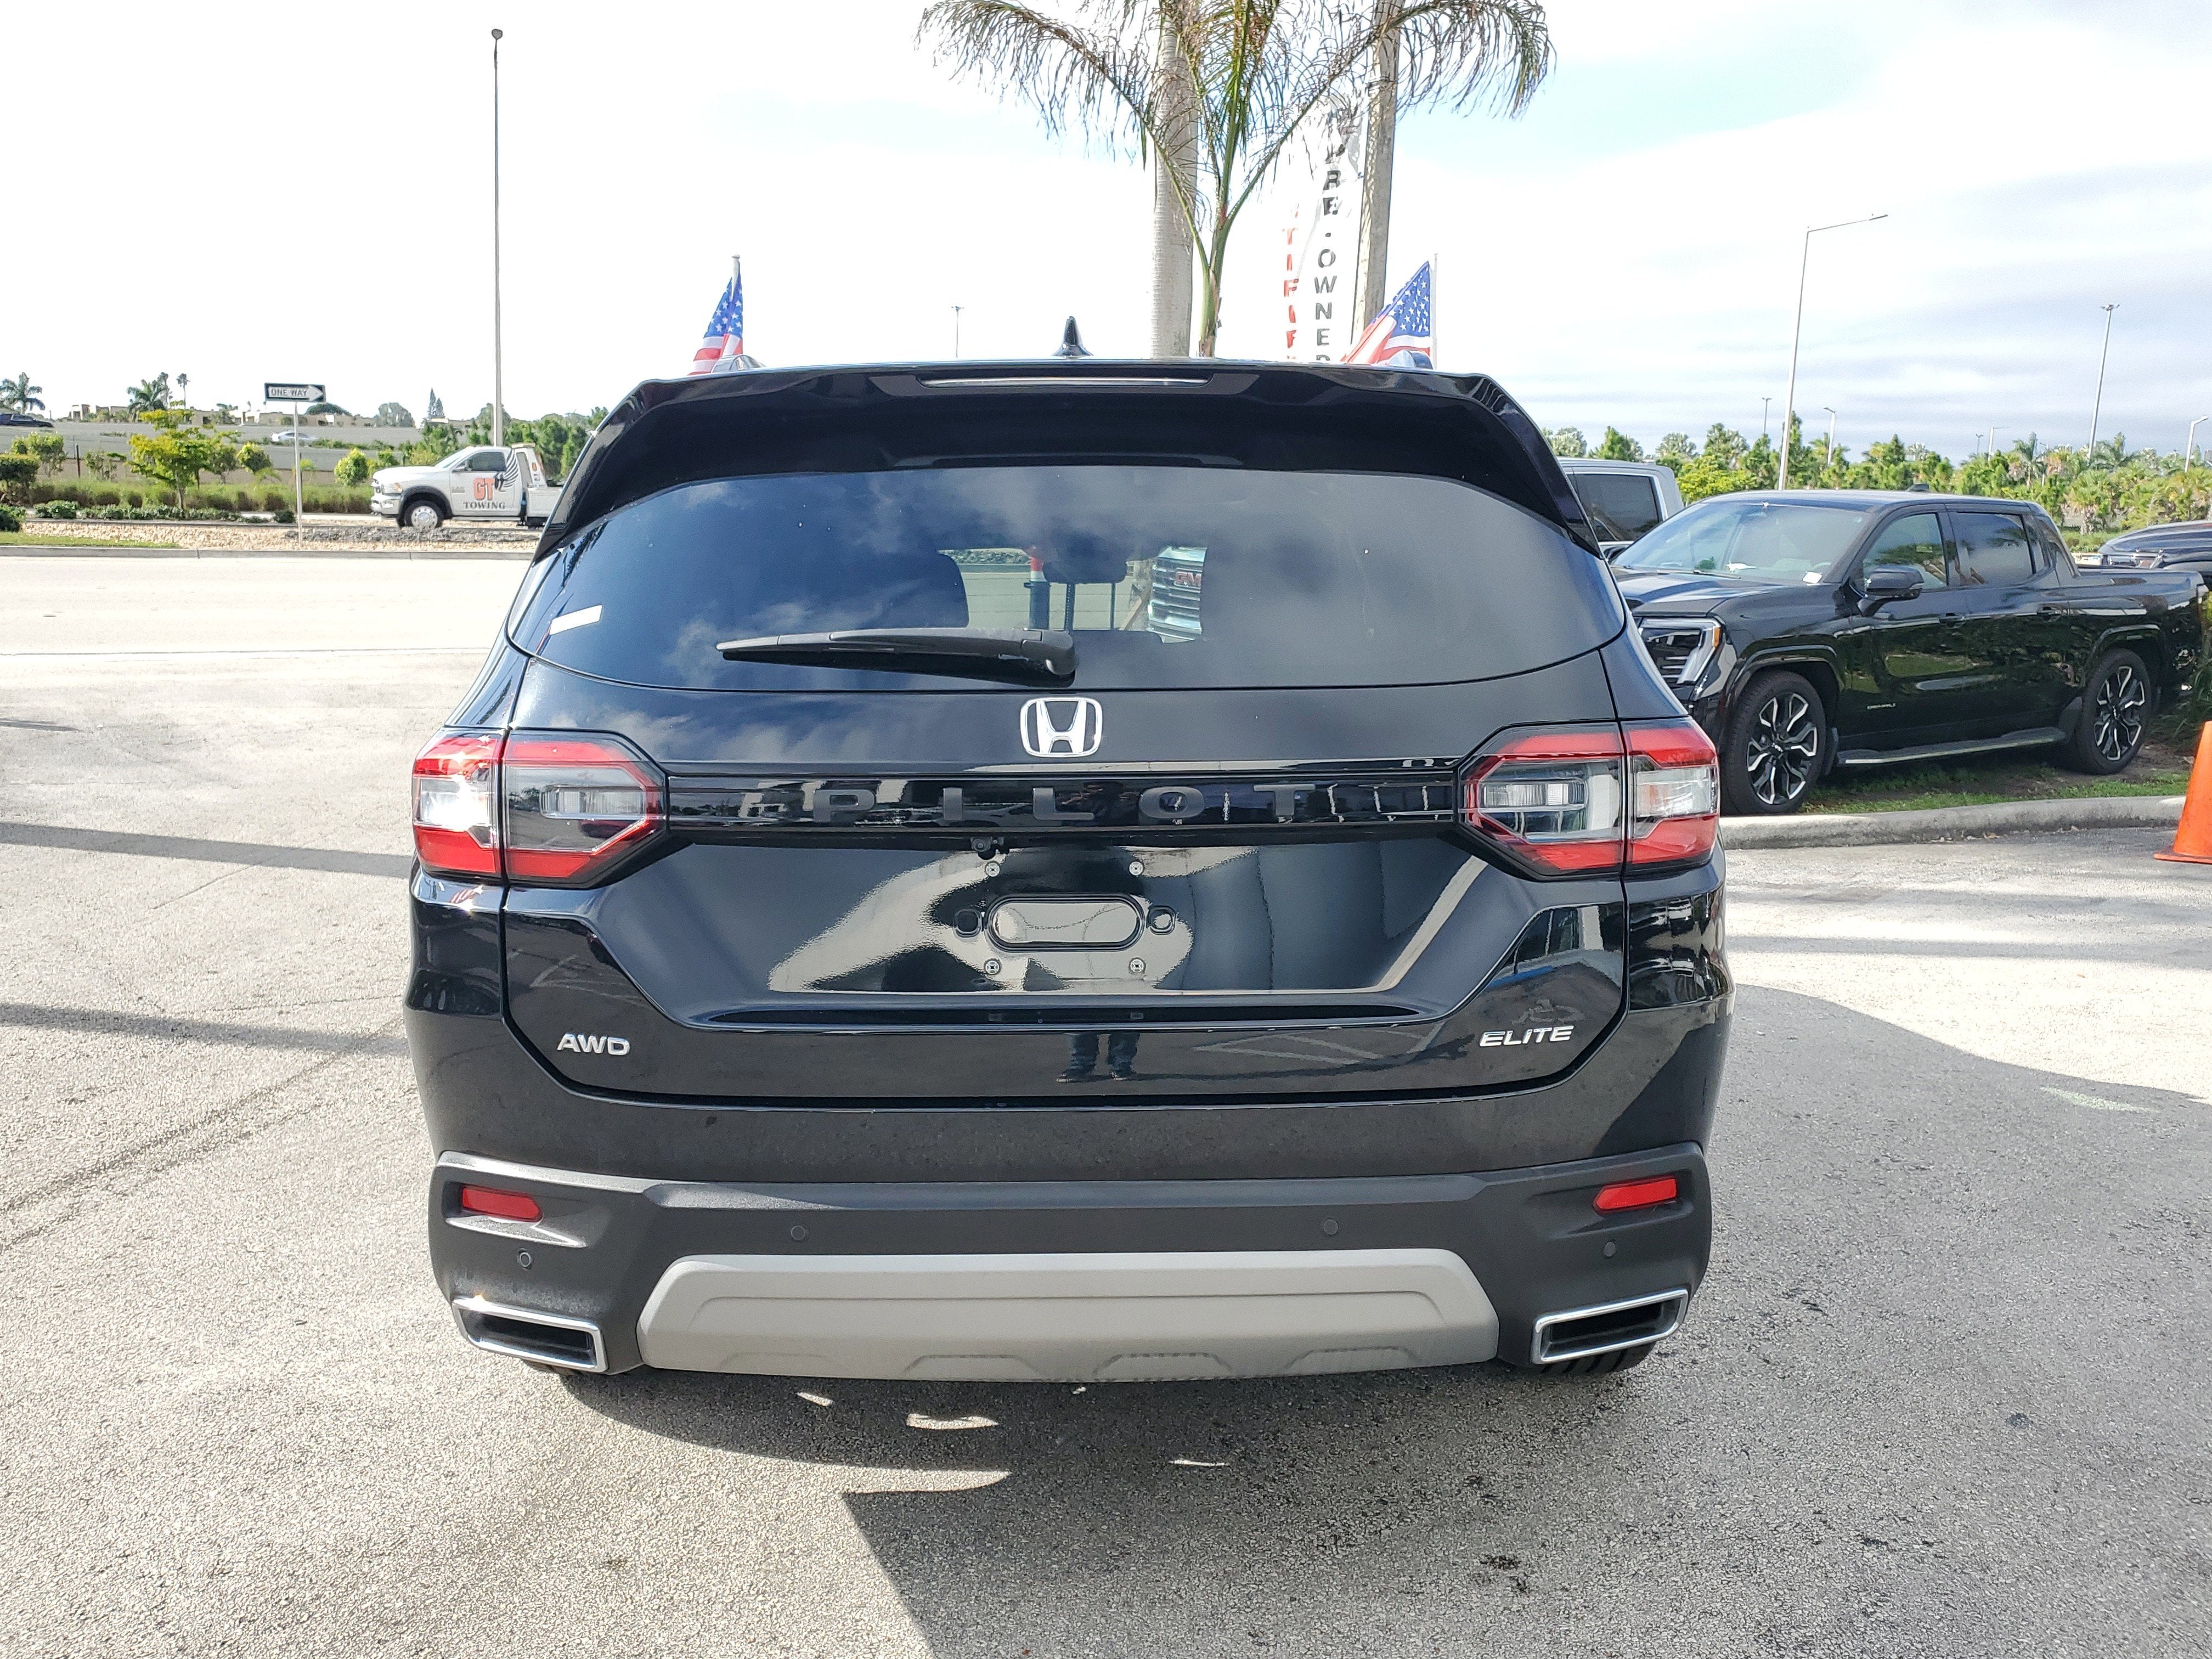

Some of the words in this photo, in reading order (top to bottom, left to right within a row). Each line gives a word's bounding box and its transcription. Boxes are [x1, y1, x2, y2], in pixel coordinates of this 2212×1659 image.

[473, 477, 495, 500] GT
[463, 501, 505, 510] TOWING
[1175, 571, 1202, 587] GM
[812, 783, 1316, 823] PILOT
[556, 1032, 631, 1056] AWD
[1479, 1025, 1575, 1047] ELITE
